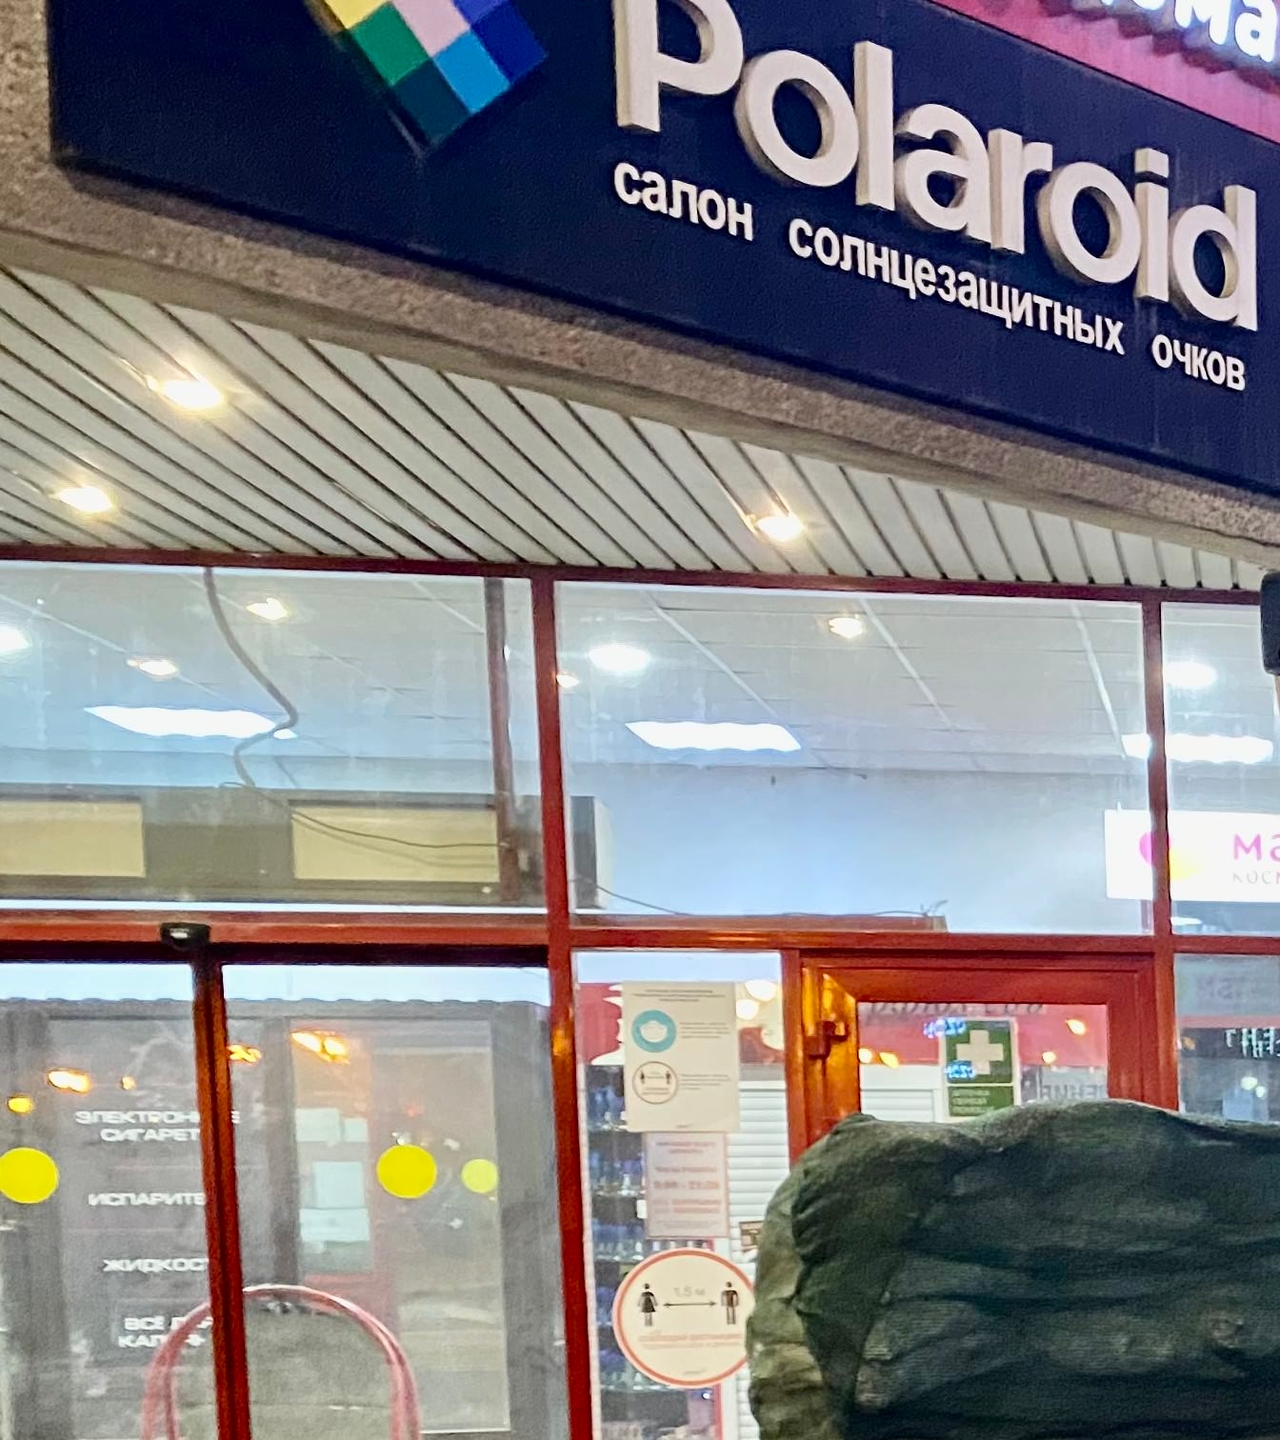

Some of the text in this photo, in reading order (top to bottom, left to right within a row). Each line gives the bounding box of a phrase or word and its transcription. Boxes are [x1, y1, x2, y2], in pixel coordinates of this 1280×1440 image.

[613, 0, 1259, 331] Polaroid
[614, 160, 1247, 392] салон солнцезащитных очков
[100, 1128, 201, 1142] СИГАРЕТ
[88, 1192, 206, 1206] ИСПАРИТЕ
